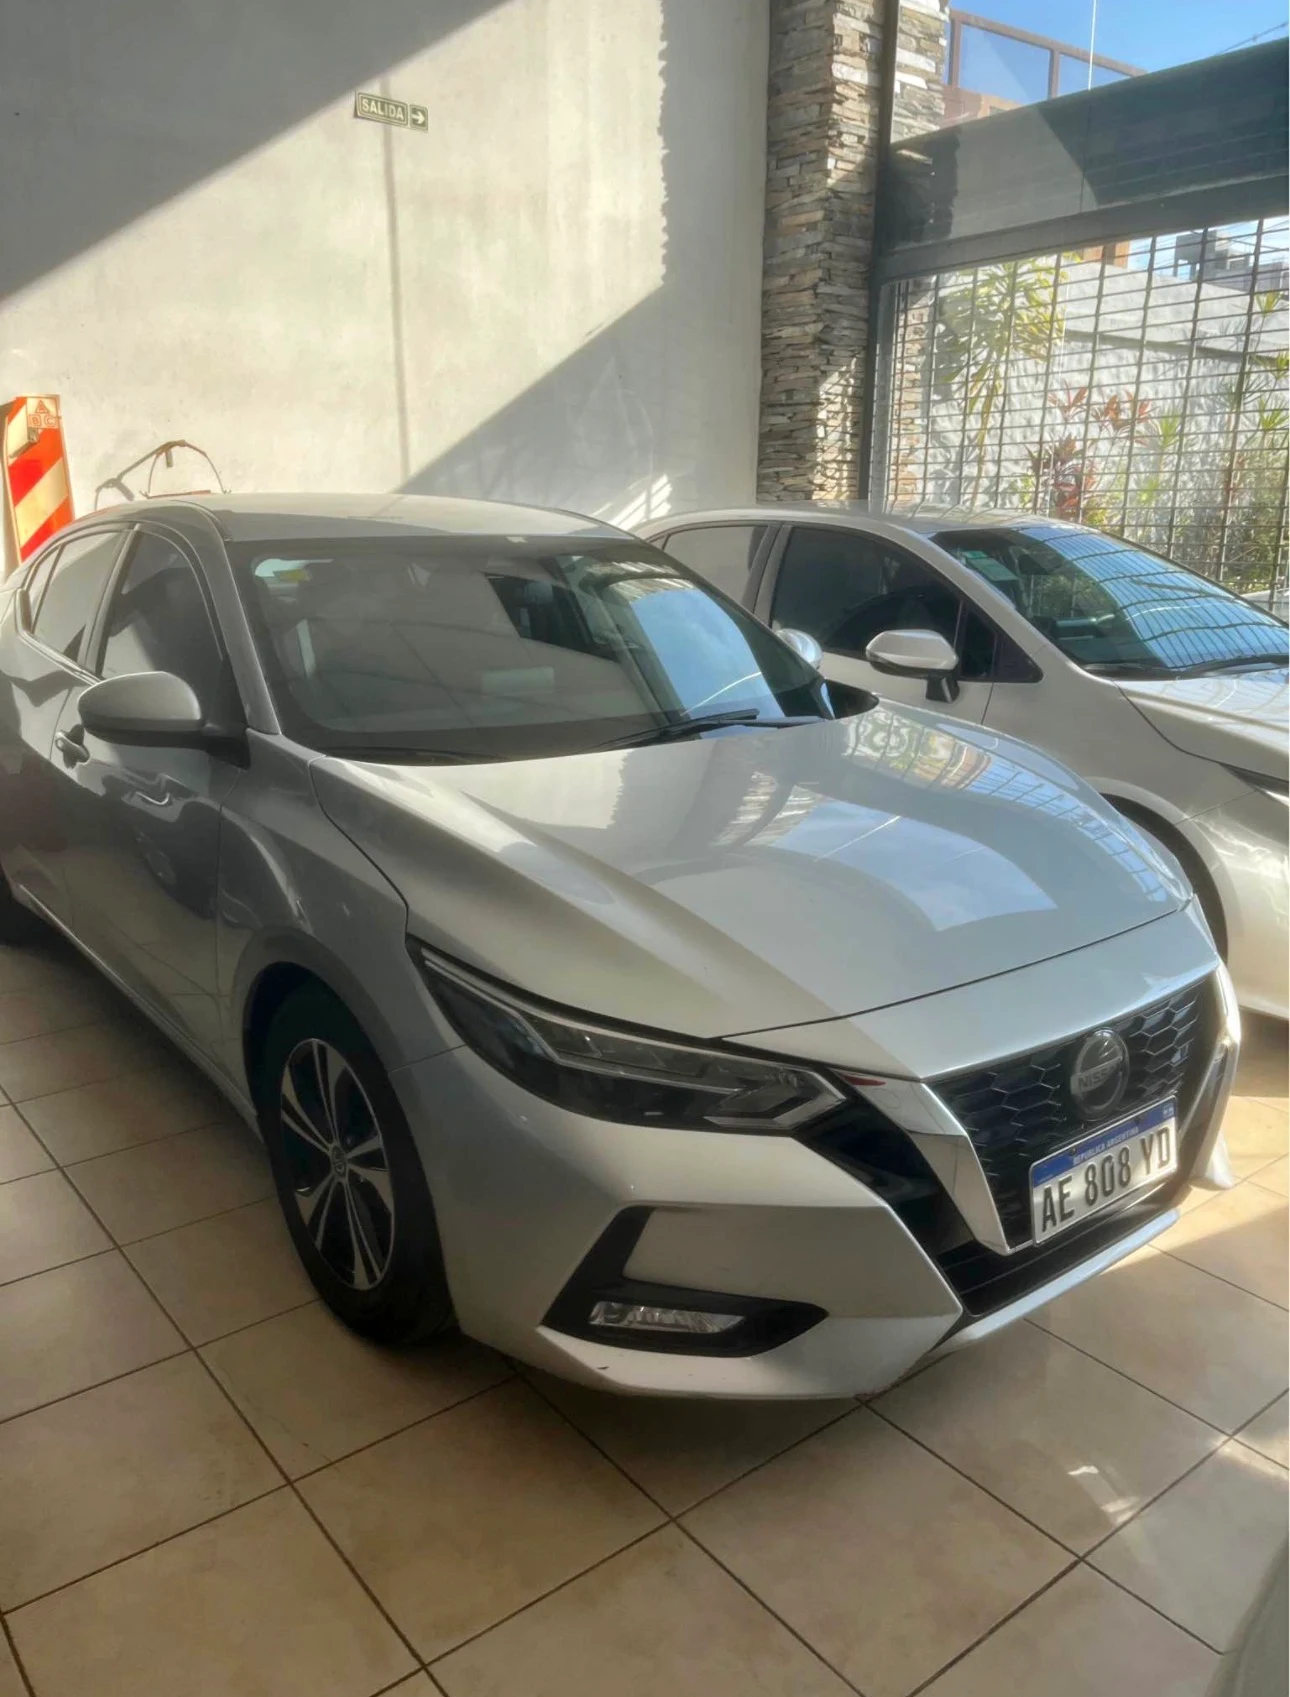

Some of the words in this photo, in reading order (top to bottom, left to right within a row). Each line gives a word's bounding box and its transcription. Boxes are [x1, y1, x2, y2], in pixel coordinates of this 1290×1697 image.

[362, 98, 404, 120] SALIDA
[1078, 1062, 1118, 1089] NISS
[1042, 1175, 1075, 1232] AE
[1085, 1146, 1131, 1206] 808
[1140, 1127, 1170, 1175] YD
